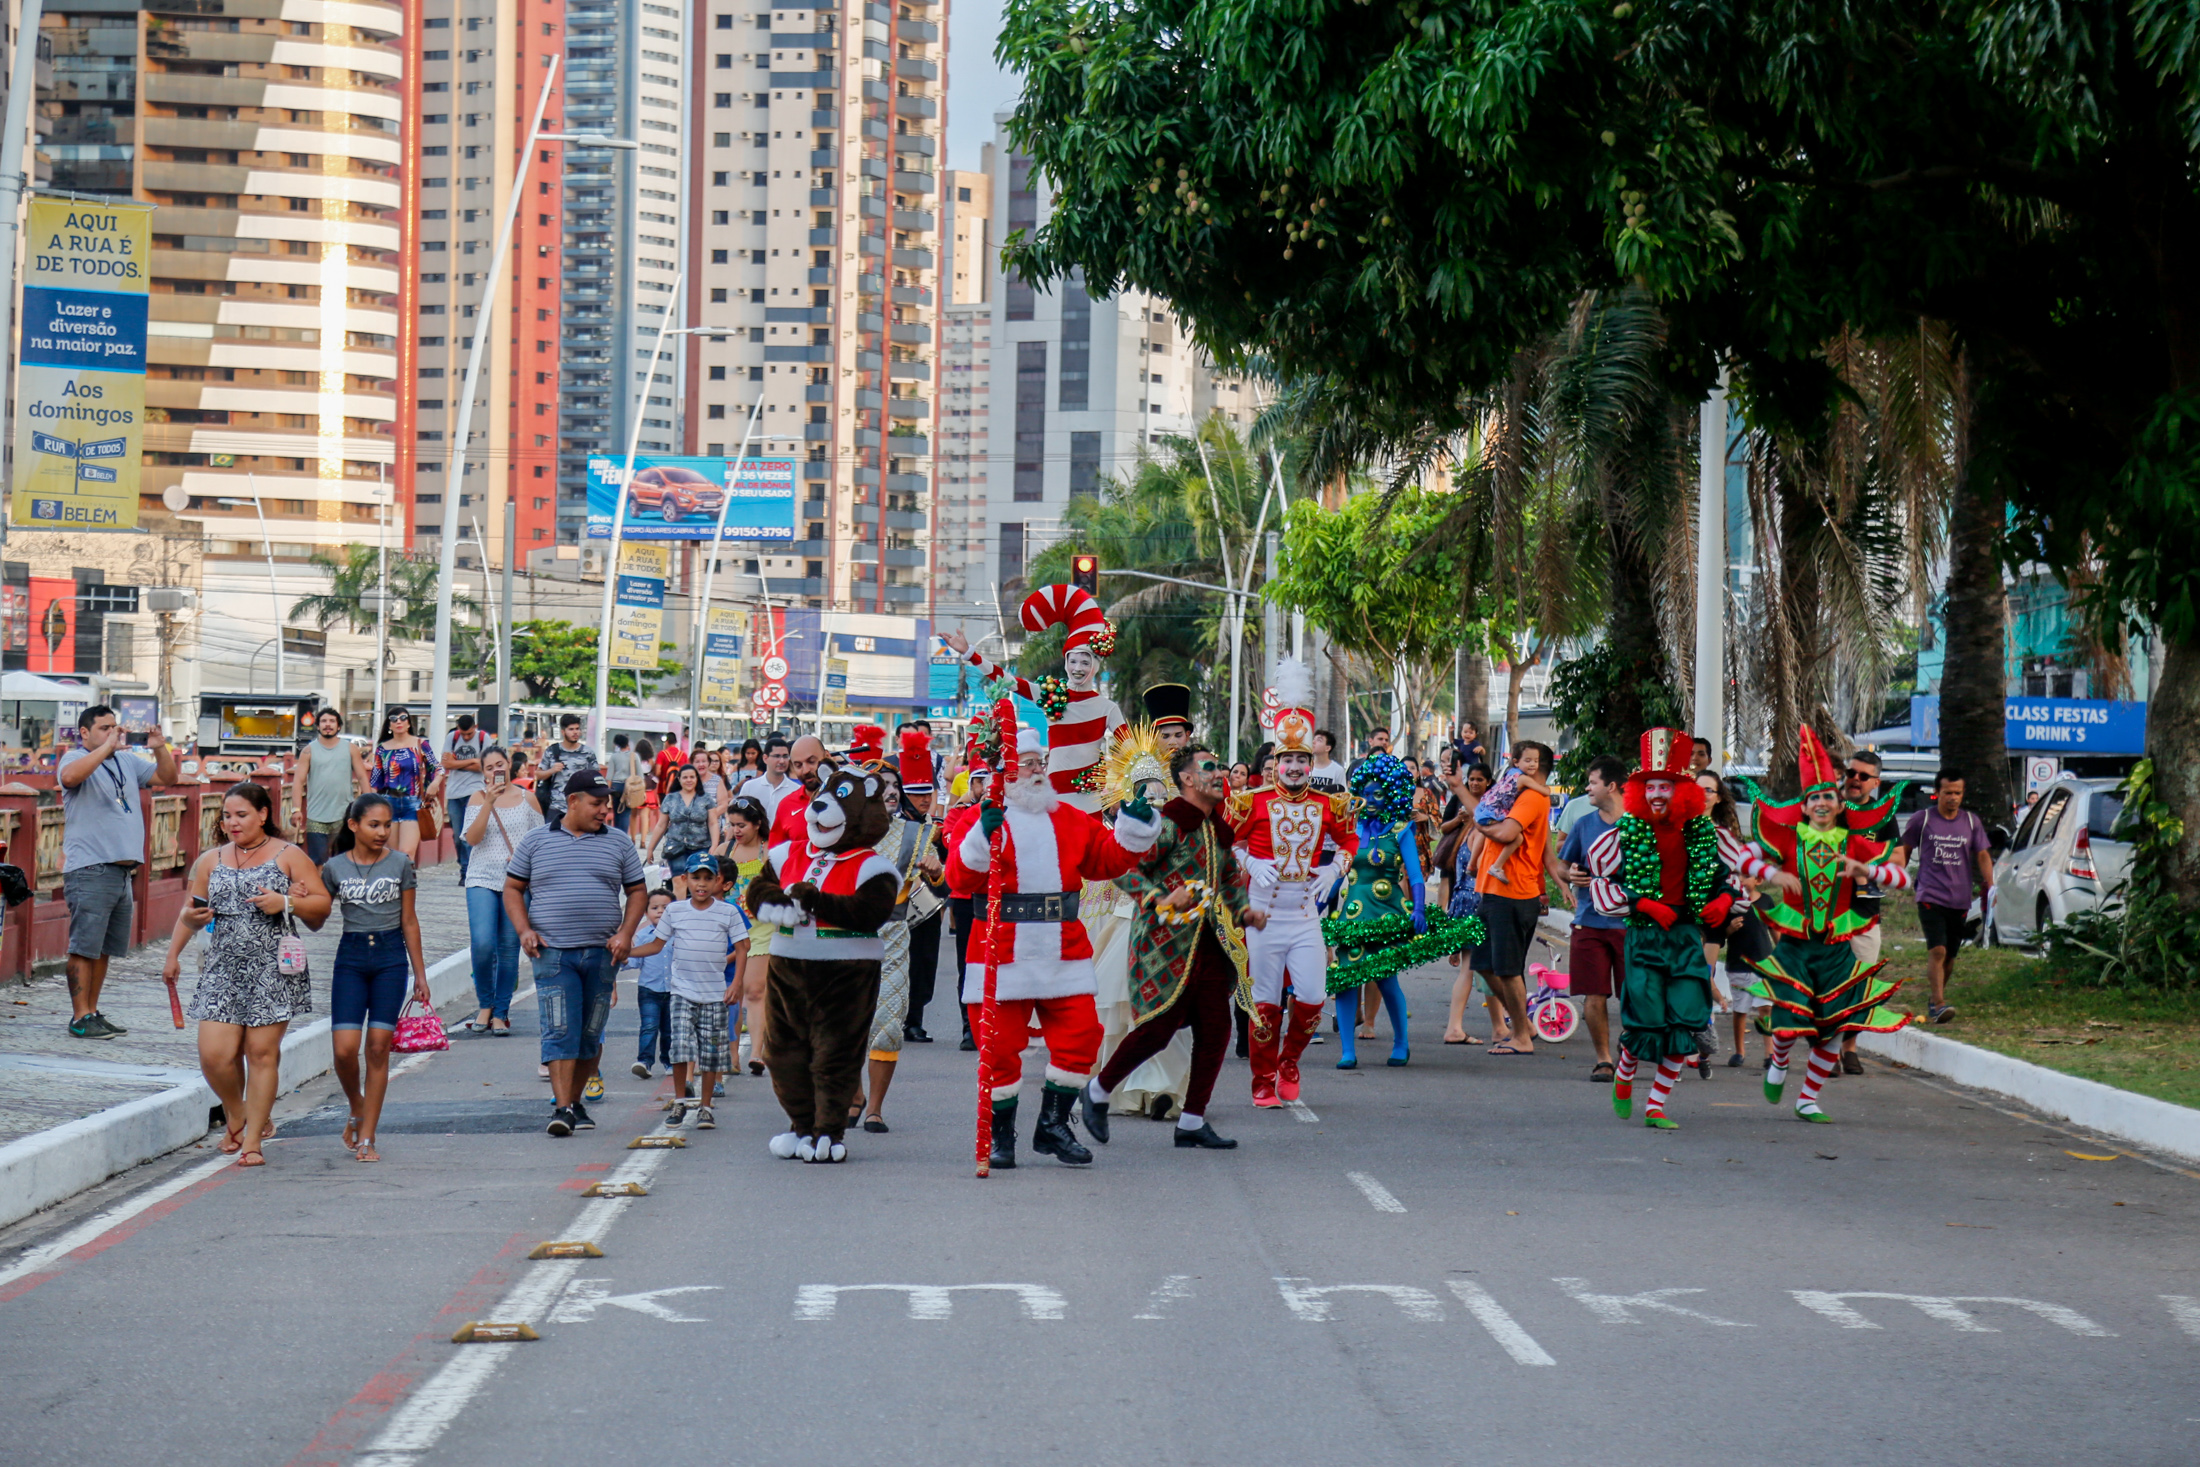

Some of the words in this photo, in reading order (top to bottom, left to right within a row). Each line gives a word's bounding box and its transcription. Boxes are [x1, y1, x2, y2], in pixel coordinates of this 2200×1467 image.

[64, 213, 118, 232] AQUI
[48, 234, 64, 250] A
[69, 235, 114, 254] RUA
[119, 235, 132, 255] É
[36, 255, 64, 272] DE
[69, 257, 142, 278] TODOS.
[56, 301, 99, 318] Lazer
[102, 307, 112, 318] e
[49, 319, 117, 336] diversão
[30, 337, 52, 349] na
[56, 338, 102, 353] maior
[104, 342, 137, 357] paz.
[62, 380, 103, 399] Aos
[29, 400, 133, 426] domingos
[44, 438, 66, 454] RUA
[86, 446, 96, 456] DE
[97, 443, 121, 454] TODOS
[760, 461, 792, 471] ZERO
[742, 471, 756, 480] 36
[757, 471, 792, 480] VEZES
[760, 481, 791, 489] BÔNUS
[739, 489, 758, 497] SEU
[759, 489, 792, 497] USADO
[64, 507, 117, 524] BELÉM
[588, 515, 612, 523] FÊNIX
[724, 527, 791, 537] 99150-3796
[635, 548, 656, 556] AQUI
[636, 556, 653, 564] RUA
[630, 611, 646, 619] Aos
[618, 618, 657, 629] domingos
[2005, 705, 2049, 722] CLASS
[2054, 707, 2108, 724] FESTAS
[2038, 766, 2047, 778] E
[1935, 847, 1960, 860] Deus
[349, 878, 367, 886] Enjoy
